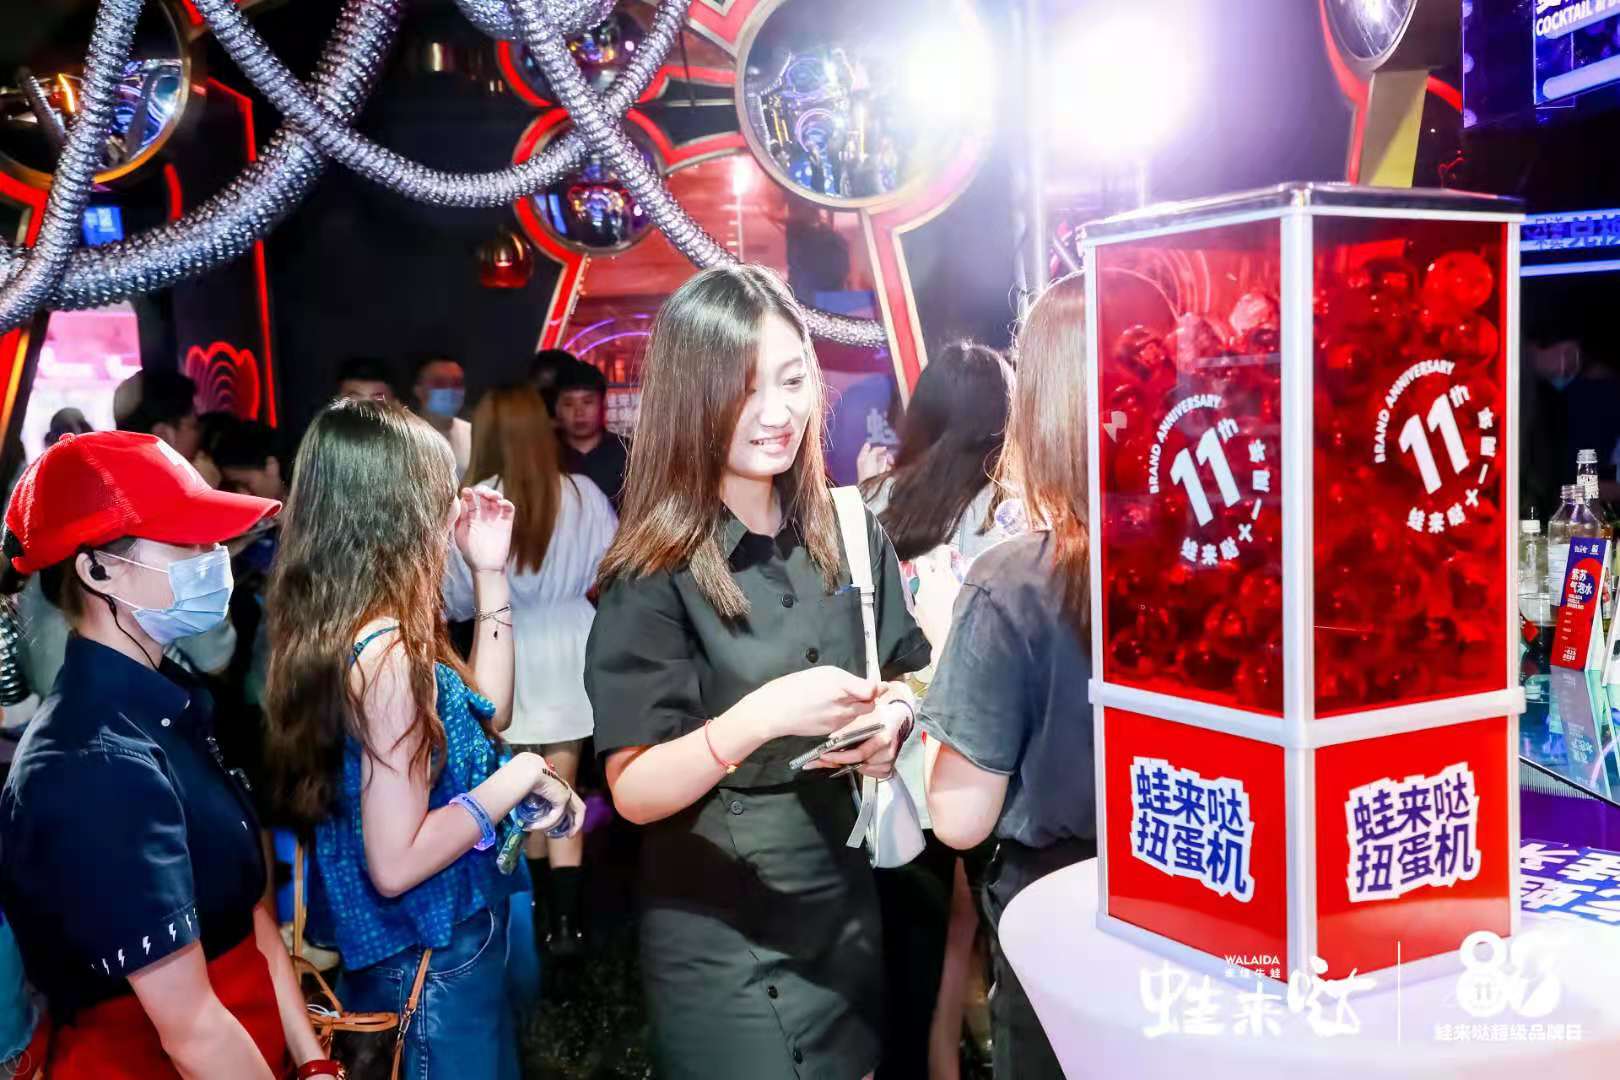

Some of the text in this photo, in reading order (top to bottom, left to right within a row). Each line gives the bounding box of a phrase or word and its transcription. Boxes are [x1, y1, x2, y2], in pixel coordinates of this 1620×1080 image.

[1536, 0, 1592, 36] COCKTAIL
[1148, 394, 1222, 494] BRAND ANNIVERSARY
[1374, 360, 1455, 463] BRAND ANNIVERSARY
[1136, 765, 1245, 837] 蛙来哒
[1354, 772, 1470, 845] 蛙来哒
[1137, 811, 1247, 893] 扭蛋机
[1356, 824, 1474, 893] 扭蛋机
